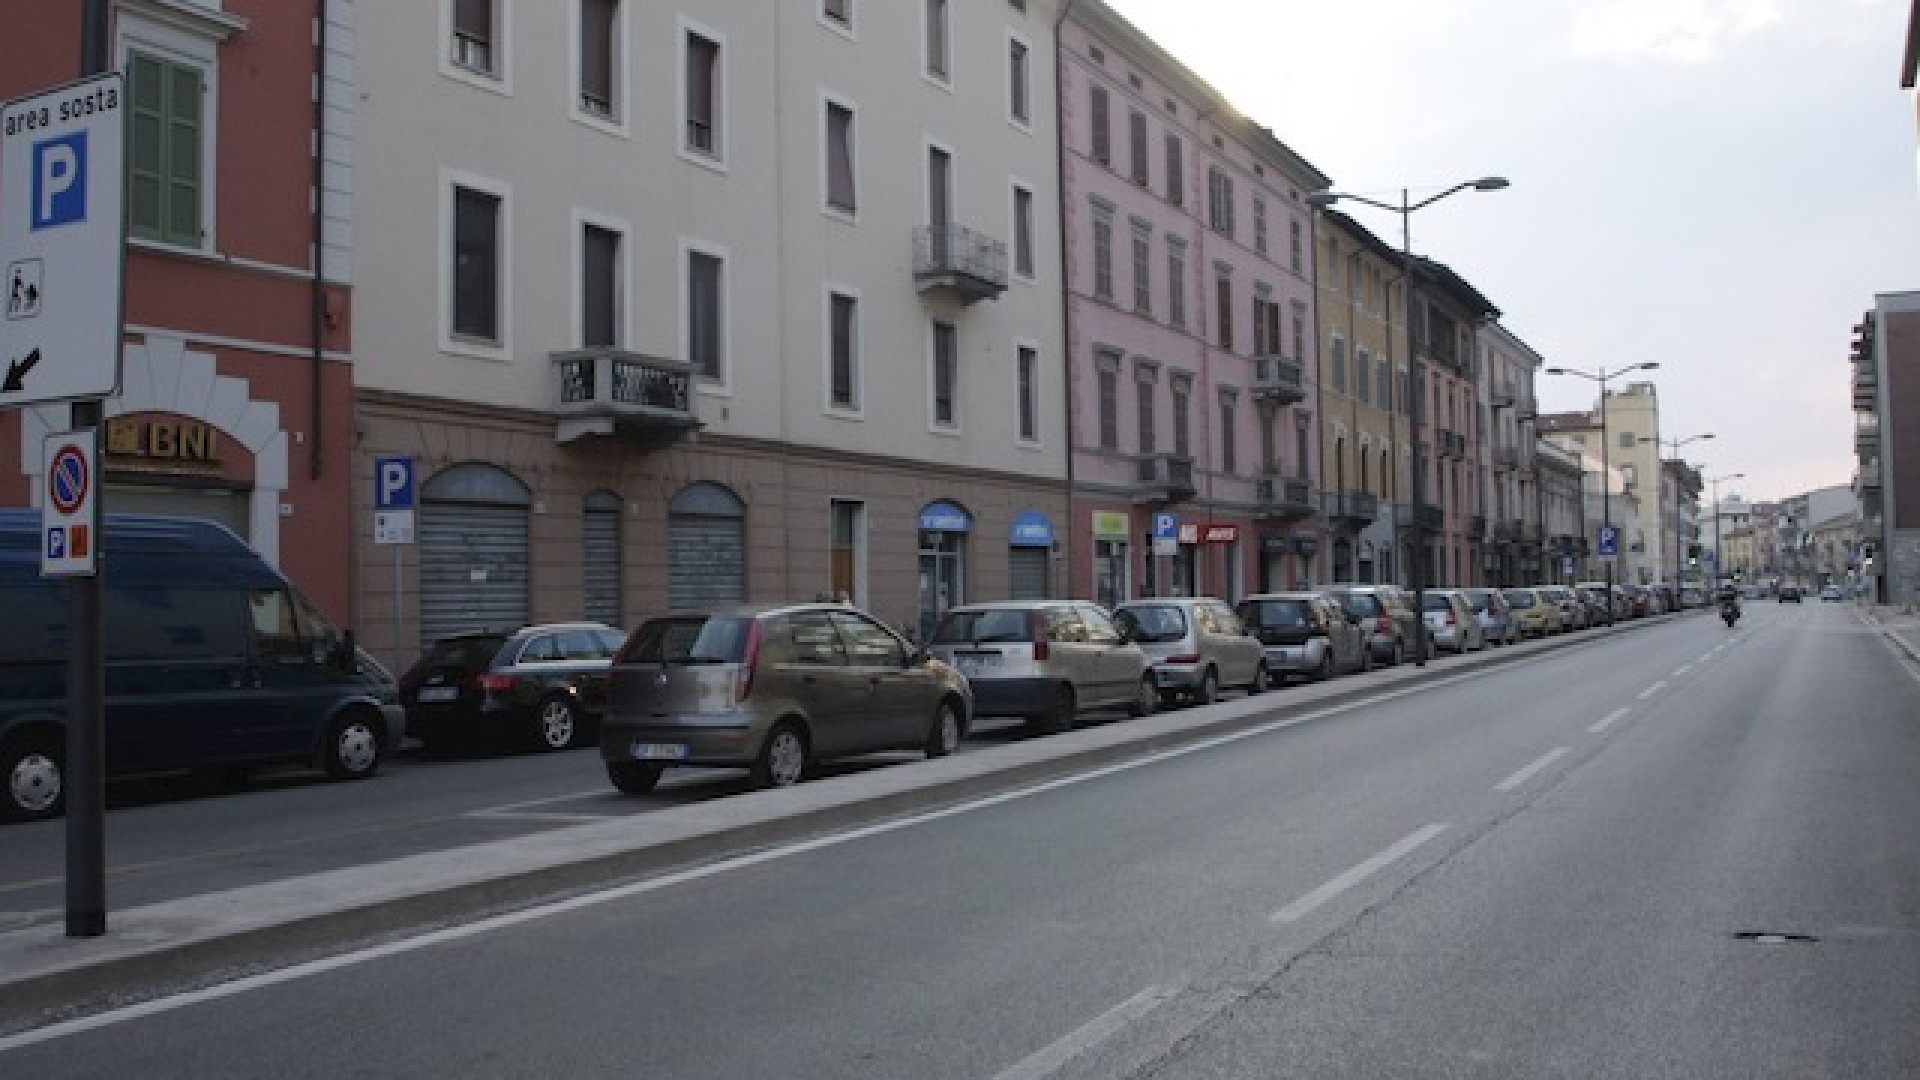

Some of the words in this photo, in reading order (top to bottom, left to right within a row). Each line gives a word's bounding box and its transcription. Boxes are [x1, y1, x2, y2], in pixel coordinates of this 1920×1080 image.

[5, 107, 49, 136] area
[59, 86, 118, 121] sosta
[41, 144, 77, 220] P
[150, 421, 217, 459] BNI
[382, 461, 409, 505] P
[50, 530, 63, 556] P
[1157, 515, 1174, 535] P
